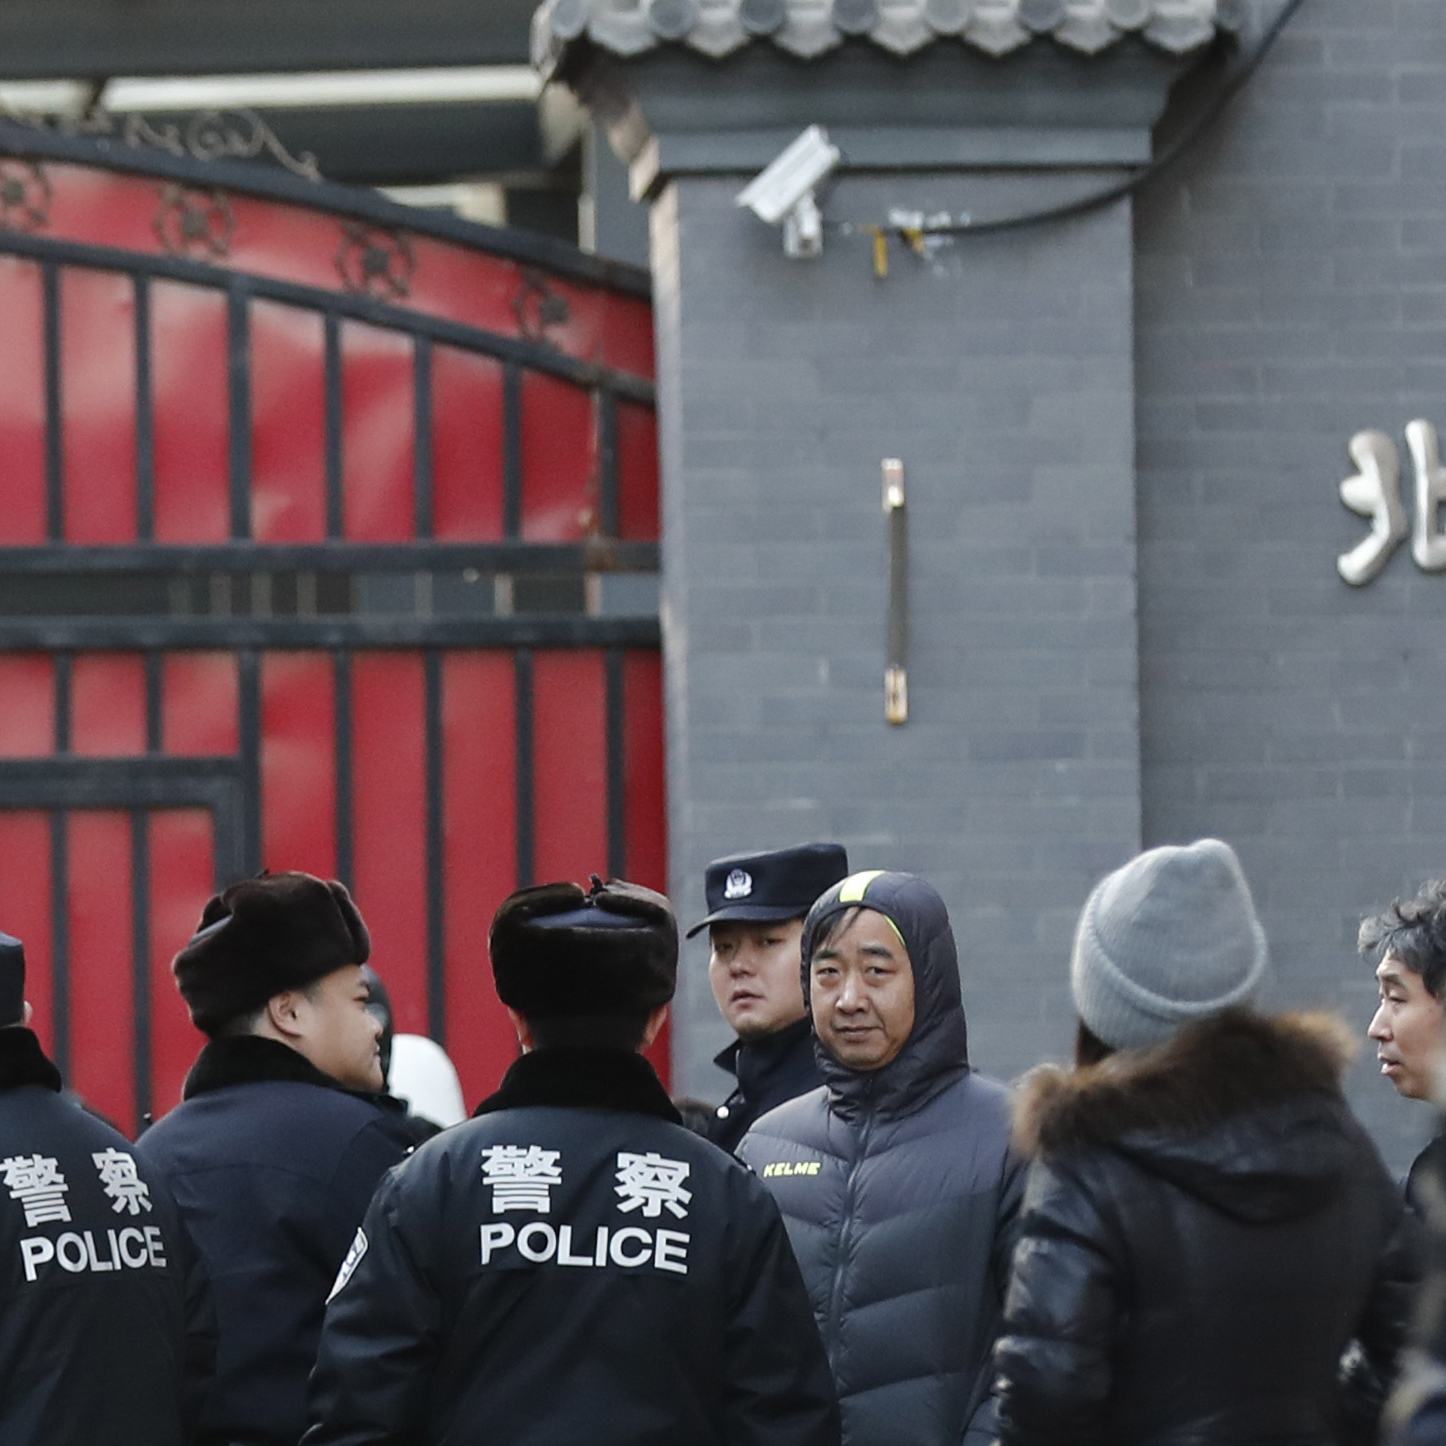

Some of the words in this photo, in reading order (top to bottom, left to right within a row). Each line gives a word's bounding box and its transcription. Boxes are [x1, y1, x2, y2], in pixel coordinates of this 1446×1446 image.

[480, 1145, 693, 1219] 警察
[762, 1161, 822, 1178] KELME
[20, 1226, 167, 1282] POLICE
[480, 1222, 691, 1275] POLICE
